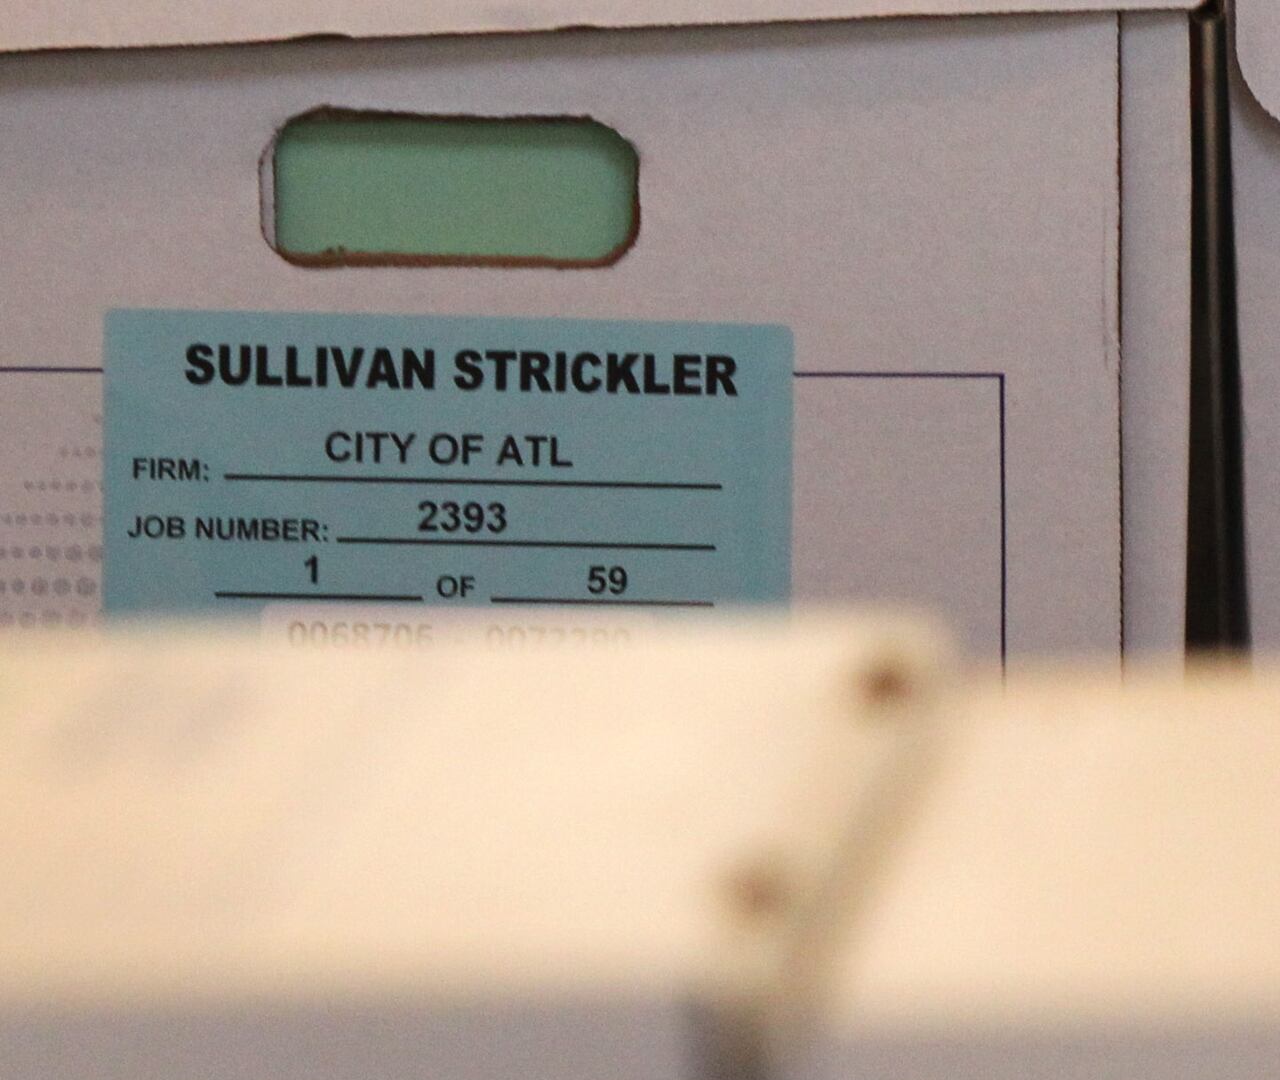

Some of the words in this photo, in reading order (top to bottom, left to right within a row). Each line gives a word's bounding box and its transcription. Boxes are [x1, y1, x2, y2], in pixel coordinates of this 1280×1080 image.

[184, 342, 436, 391] SULLIVAN
[453, 348, 738, 397] STRICKLER
[132, 457, 209, 482] FIRM:
[324, 430, 416, 464] CITY
[428, 432, 484, 466] OF
[496, 434, 573, 468] ATL
[127, 514, 187, 540] JOB
[195, 517, 328, 542] NUMBER:
[417, 500, 508, 534] 2393
[304, 554, 319, 585] 1
[435, 574, 475, 599] OF
[587, 565, 629, 596] 59
